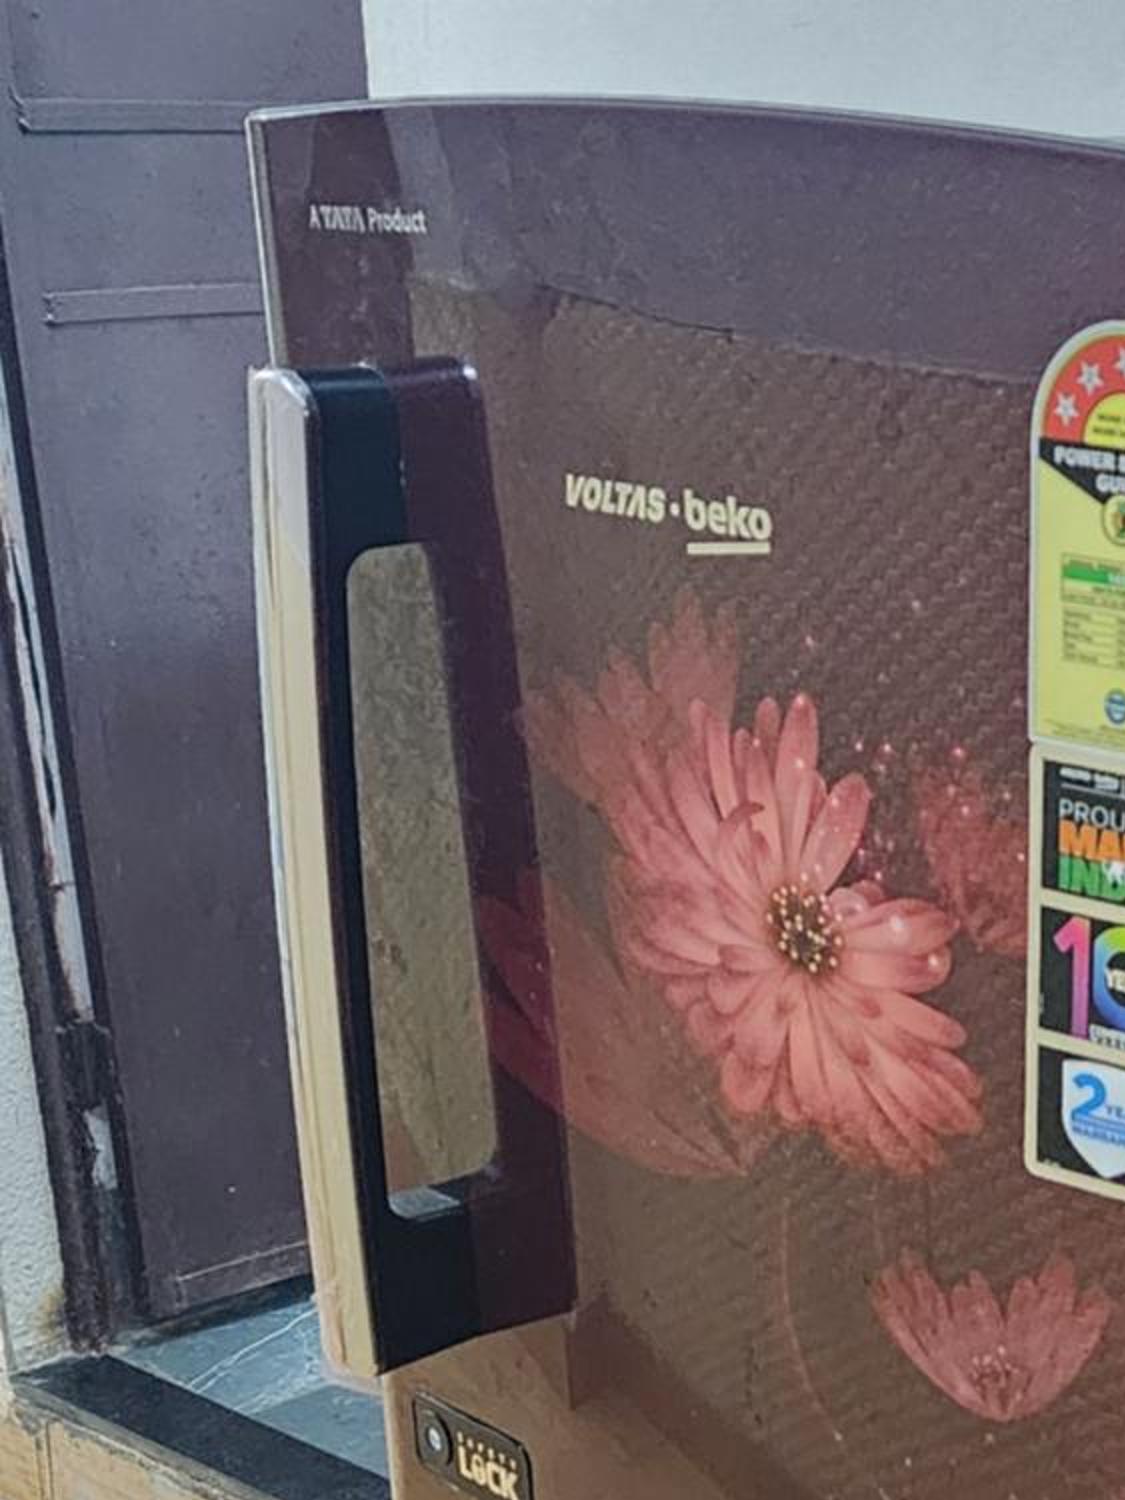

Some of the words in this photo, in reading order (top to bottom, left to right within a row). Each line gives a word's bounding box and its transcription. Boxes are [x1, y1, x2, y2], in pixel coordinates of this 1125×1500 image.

[319, 204, 366, 234] TATA
[366, 205, 428, 235] Product
[564, 473, 666, 523] VOLTAS
[683, 487, 773, 540] beko
[1071, 1072, 1107, 1122] 2
